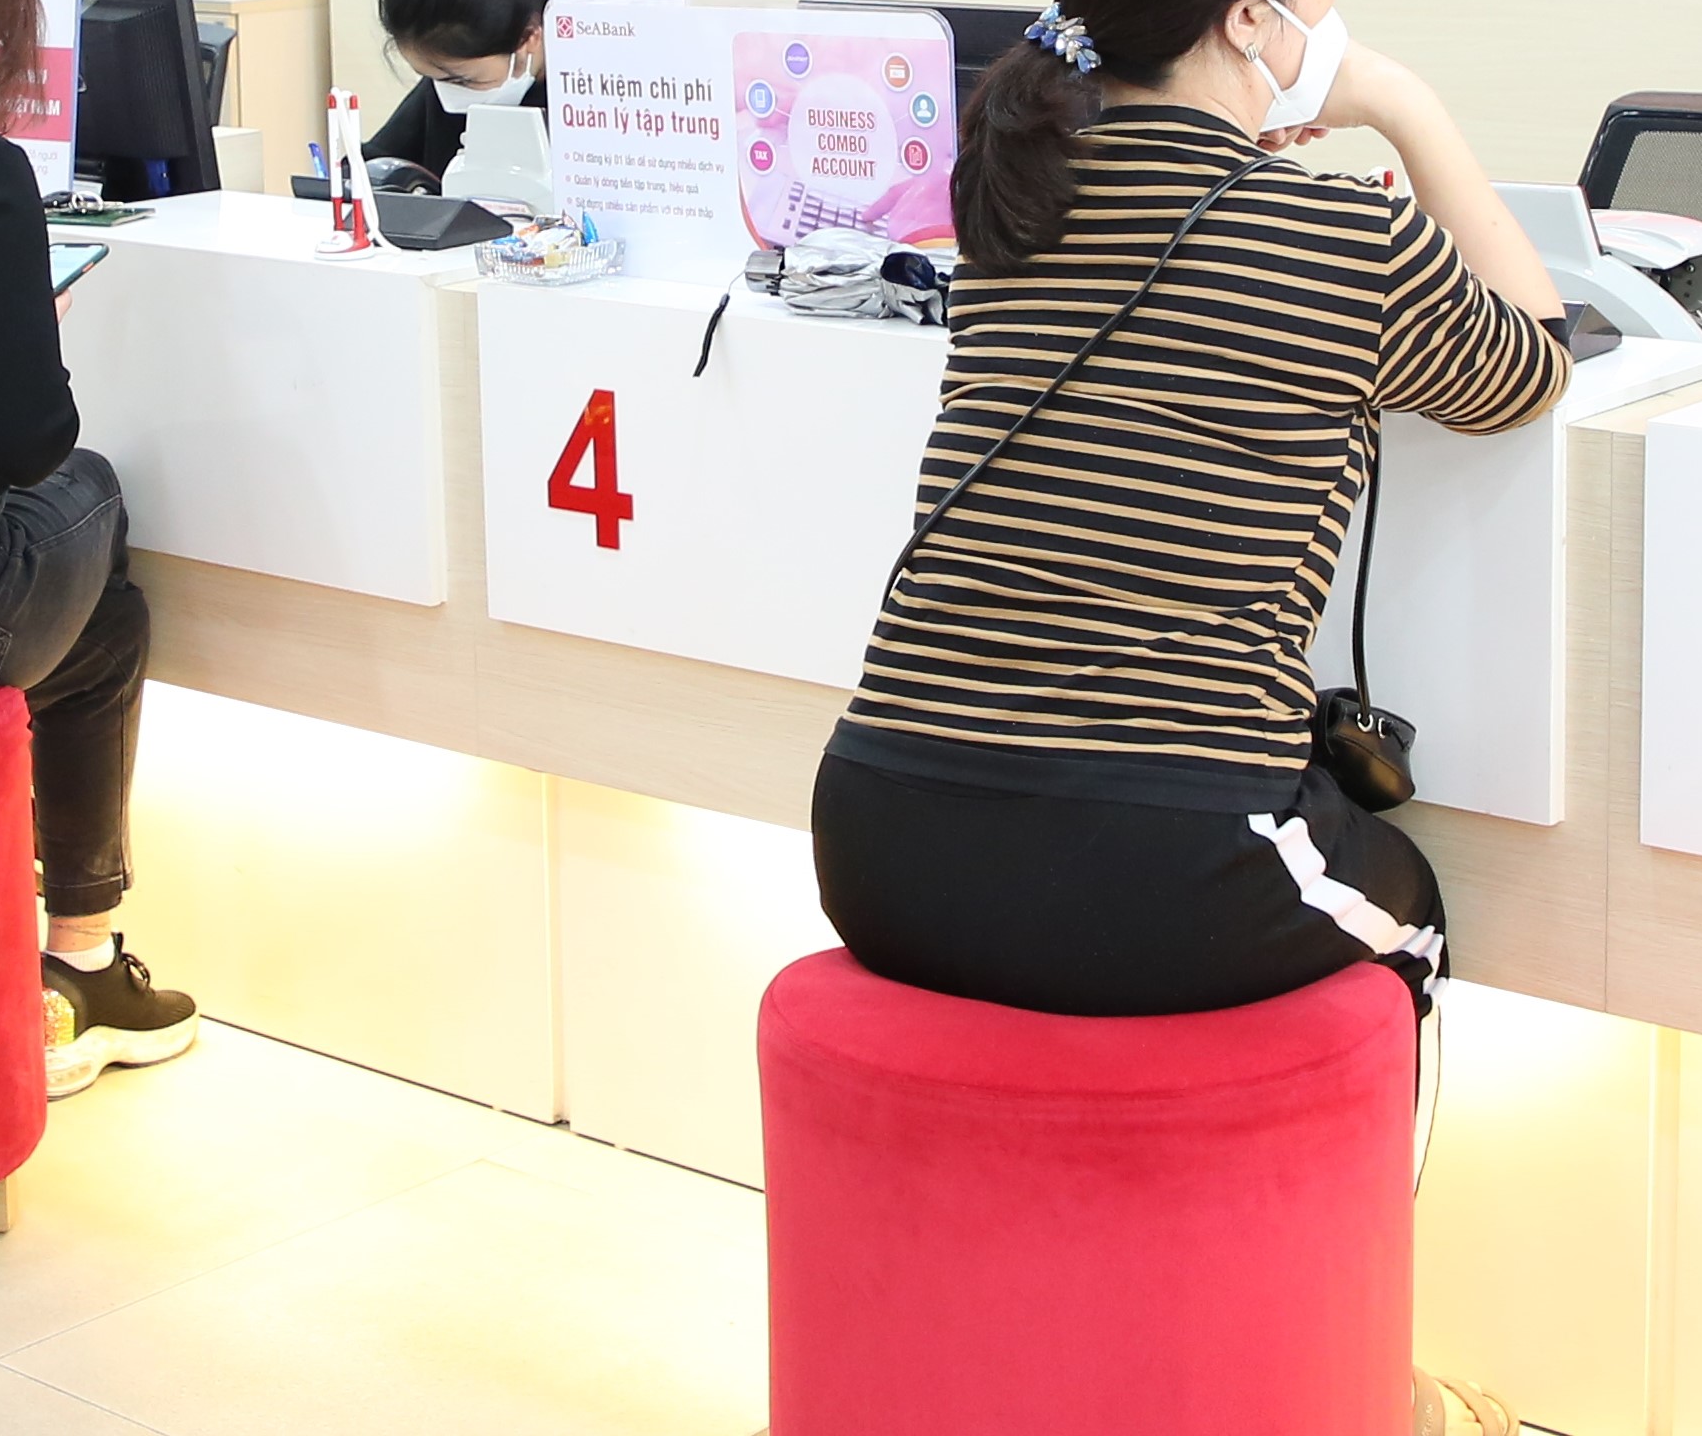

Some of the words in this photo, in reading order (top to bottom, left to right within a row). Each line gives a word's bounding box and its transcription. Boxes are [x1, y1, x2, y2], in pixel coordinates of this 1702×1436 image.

[577, 21, 635, 37] SeABank
[560, 68, 593, 95] Tiết
[600, 74, 642, 102] kiệm
[650, 77, 676, 99] chi
[684, 78, 712, 105] phí
[563, 104, 607, 128] Quản
[614, 107, 629, 134] lý
[636, 109, 664, 137] tập
[672, 111, 720, 140] trung
[808, 109, 875, 129] BUSINESS
[818, 134, 866, 153] COMBO
[755, 150, 768, 160] TAX
[812, 157, 875, 177] ACCOUNT
[548, 388, 633, 550] 4
